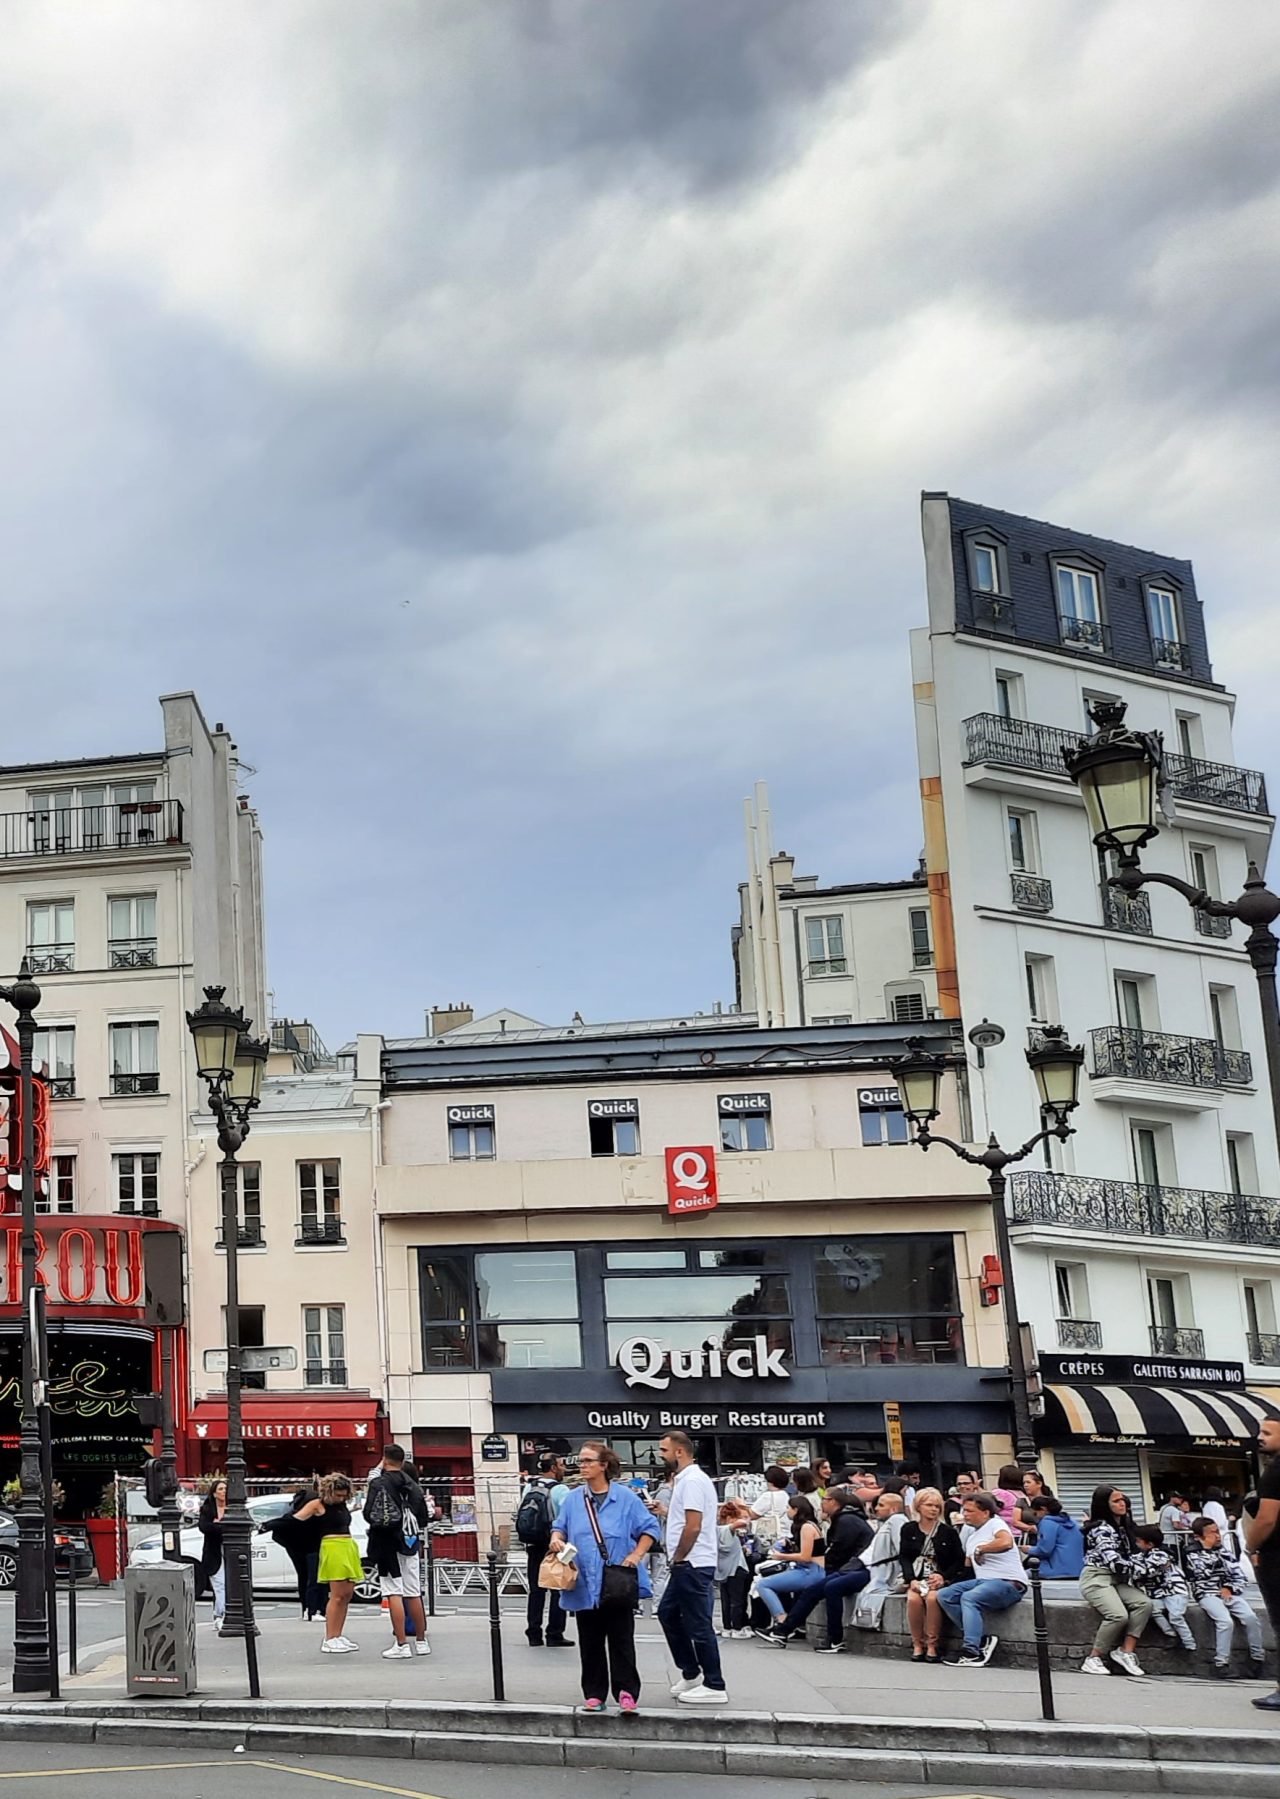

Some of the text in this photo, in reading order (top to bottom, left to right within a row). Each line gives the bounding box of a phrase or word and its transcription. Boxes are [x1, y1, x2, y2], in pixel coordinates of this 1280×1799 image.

[720, 1095, 768, 1112] Quick
[859, 1088, 902, 1105] Quic
[448, 1105, 493, 1122] Quick
[590, 1100, 636, 1117] Quick
[672, 1151, 710, 1191] Q
[674, 1195, 712, 1209] Quick
[6, 1228, 145, 1307] ROU
[618, 1334, 791, 1390] Quick
[1059, 1361, 1105, 1376] CRÊPES
[1133, 1363, 1242, 1383] GALETTES SARRASIN BIO
[587, 1411, 826, 1430] Quality Burger Restaurant
[241, 1424, 331, 1437] ILLETTERIE
